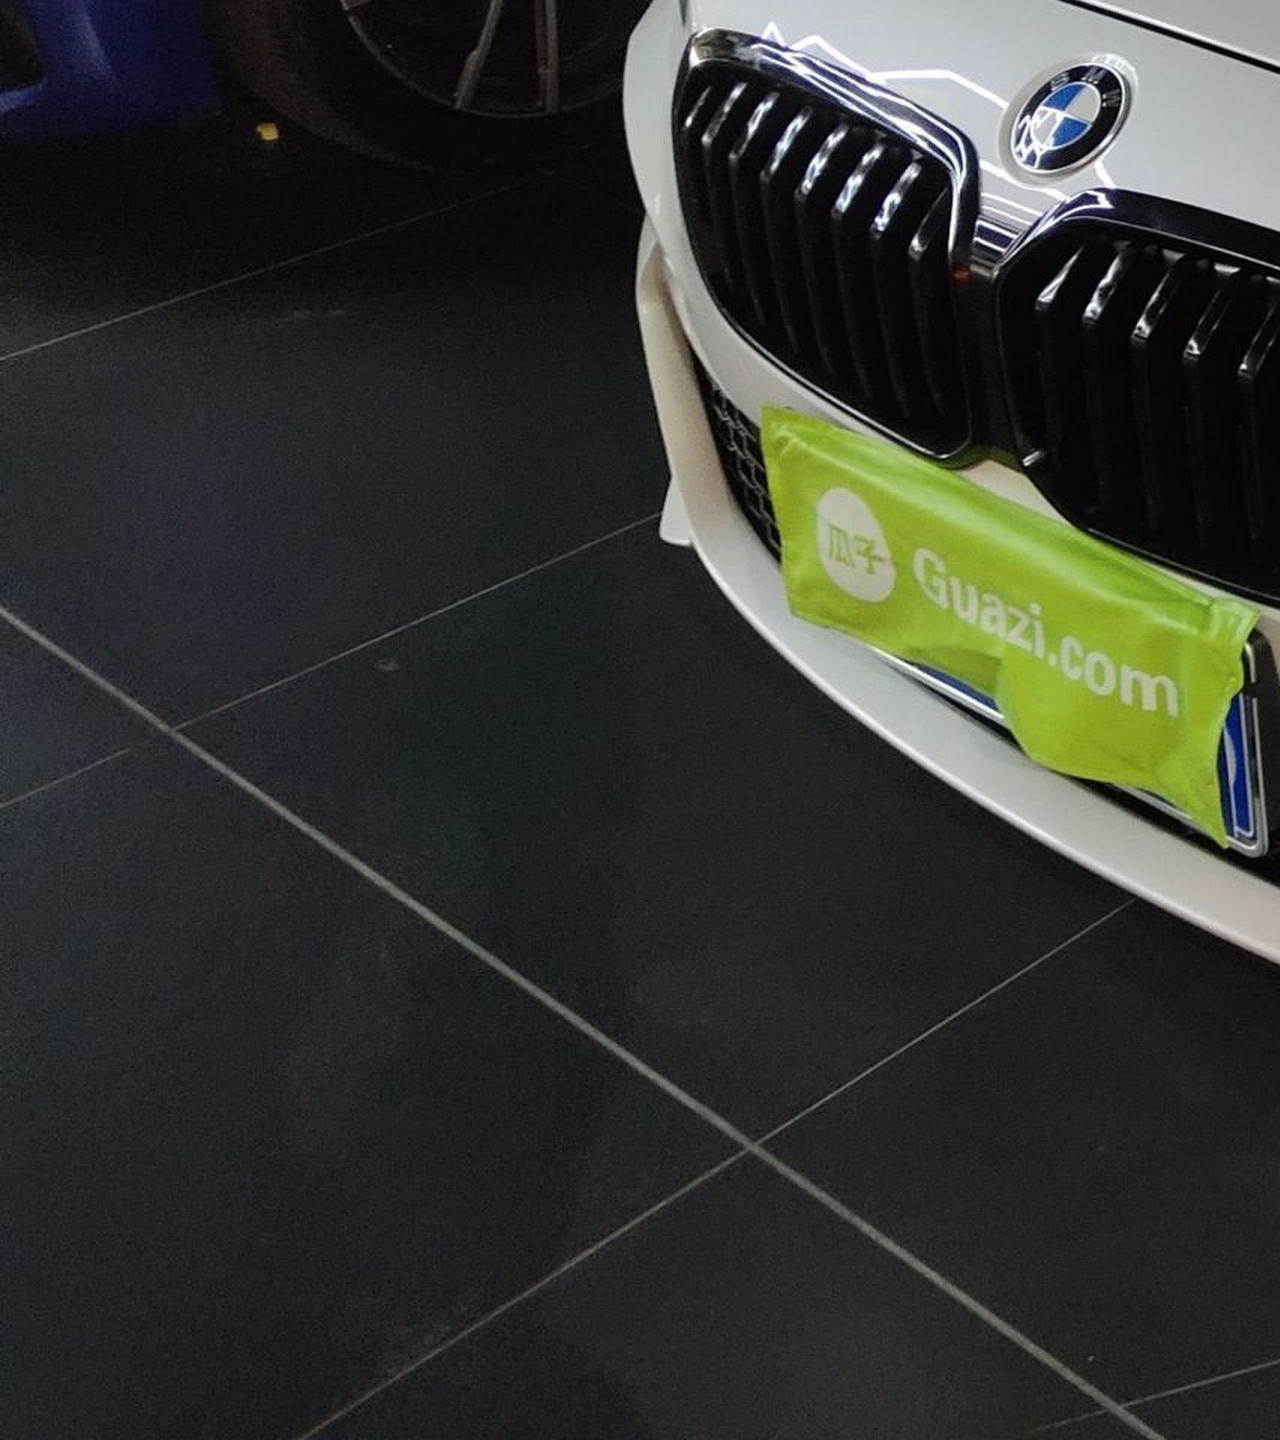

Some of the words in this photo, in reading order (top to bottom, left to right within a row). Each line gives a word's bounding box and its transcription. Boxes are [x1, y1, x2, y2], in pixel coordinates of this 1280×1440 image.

[1050, 64, 1121, 108] BMW
[827, 523, 884, 575] 瓜子
[913, 547, 1180, 719] Guazi.com
